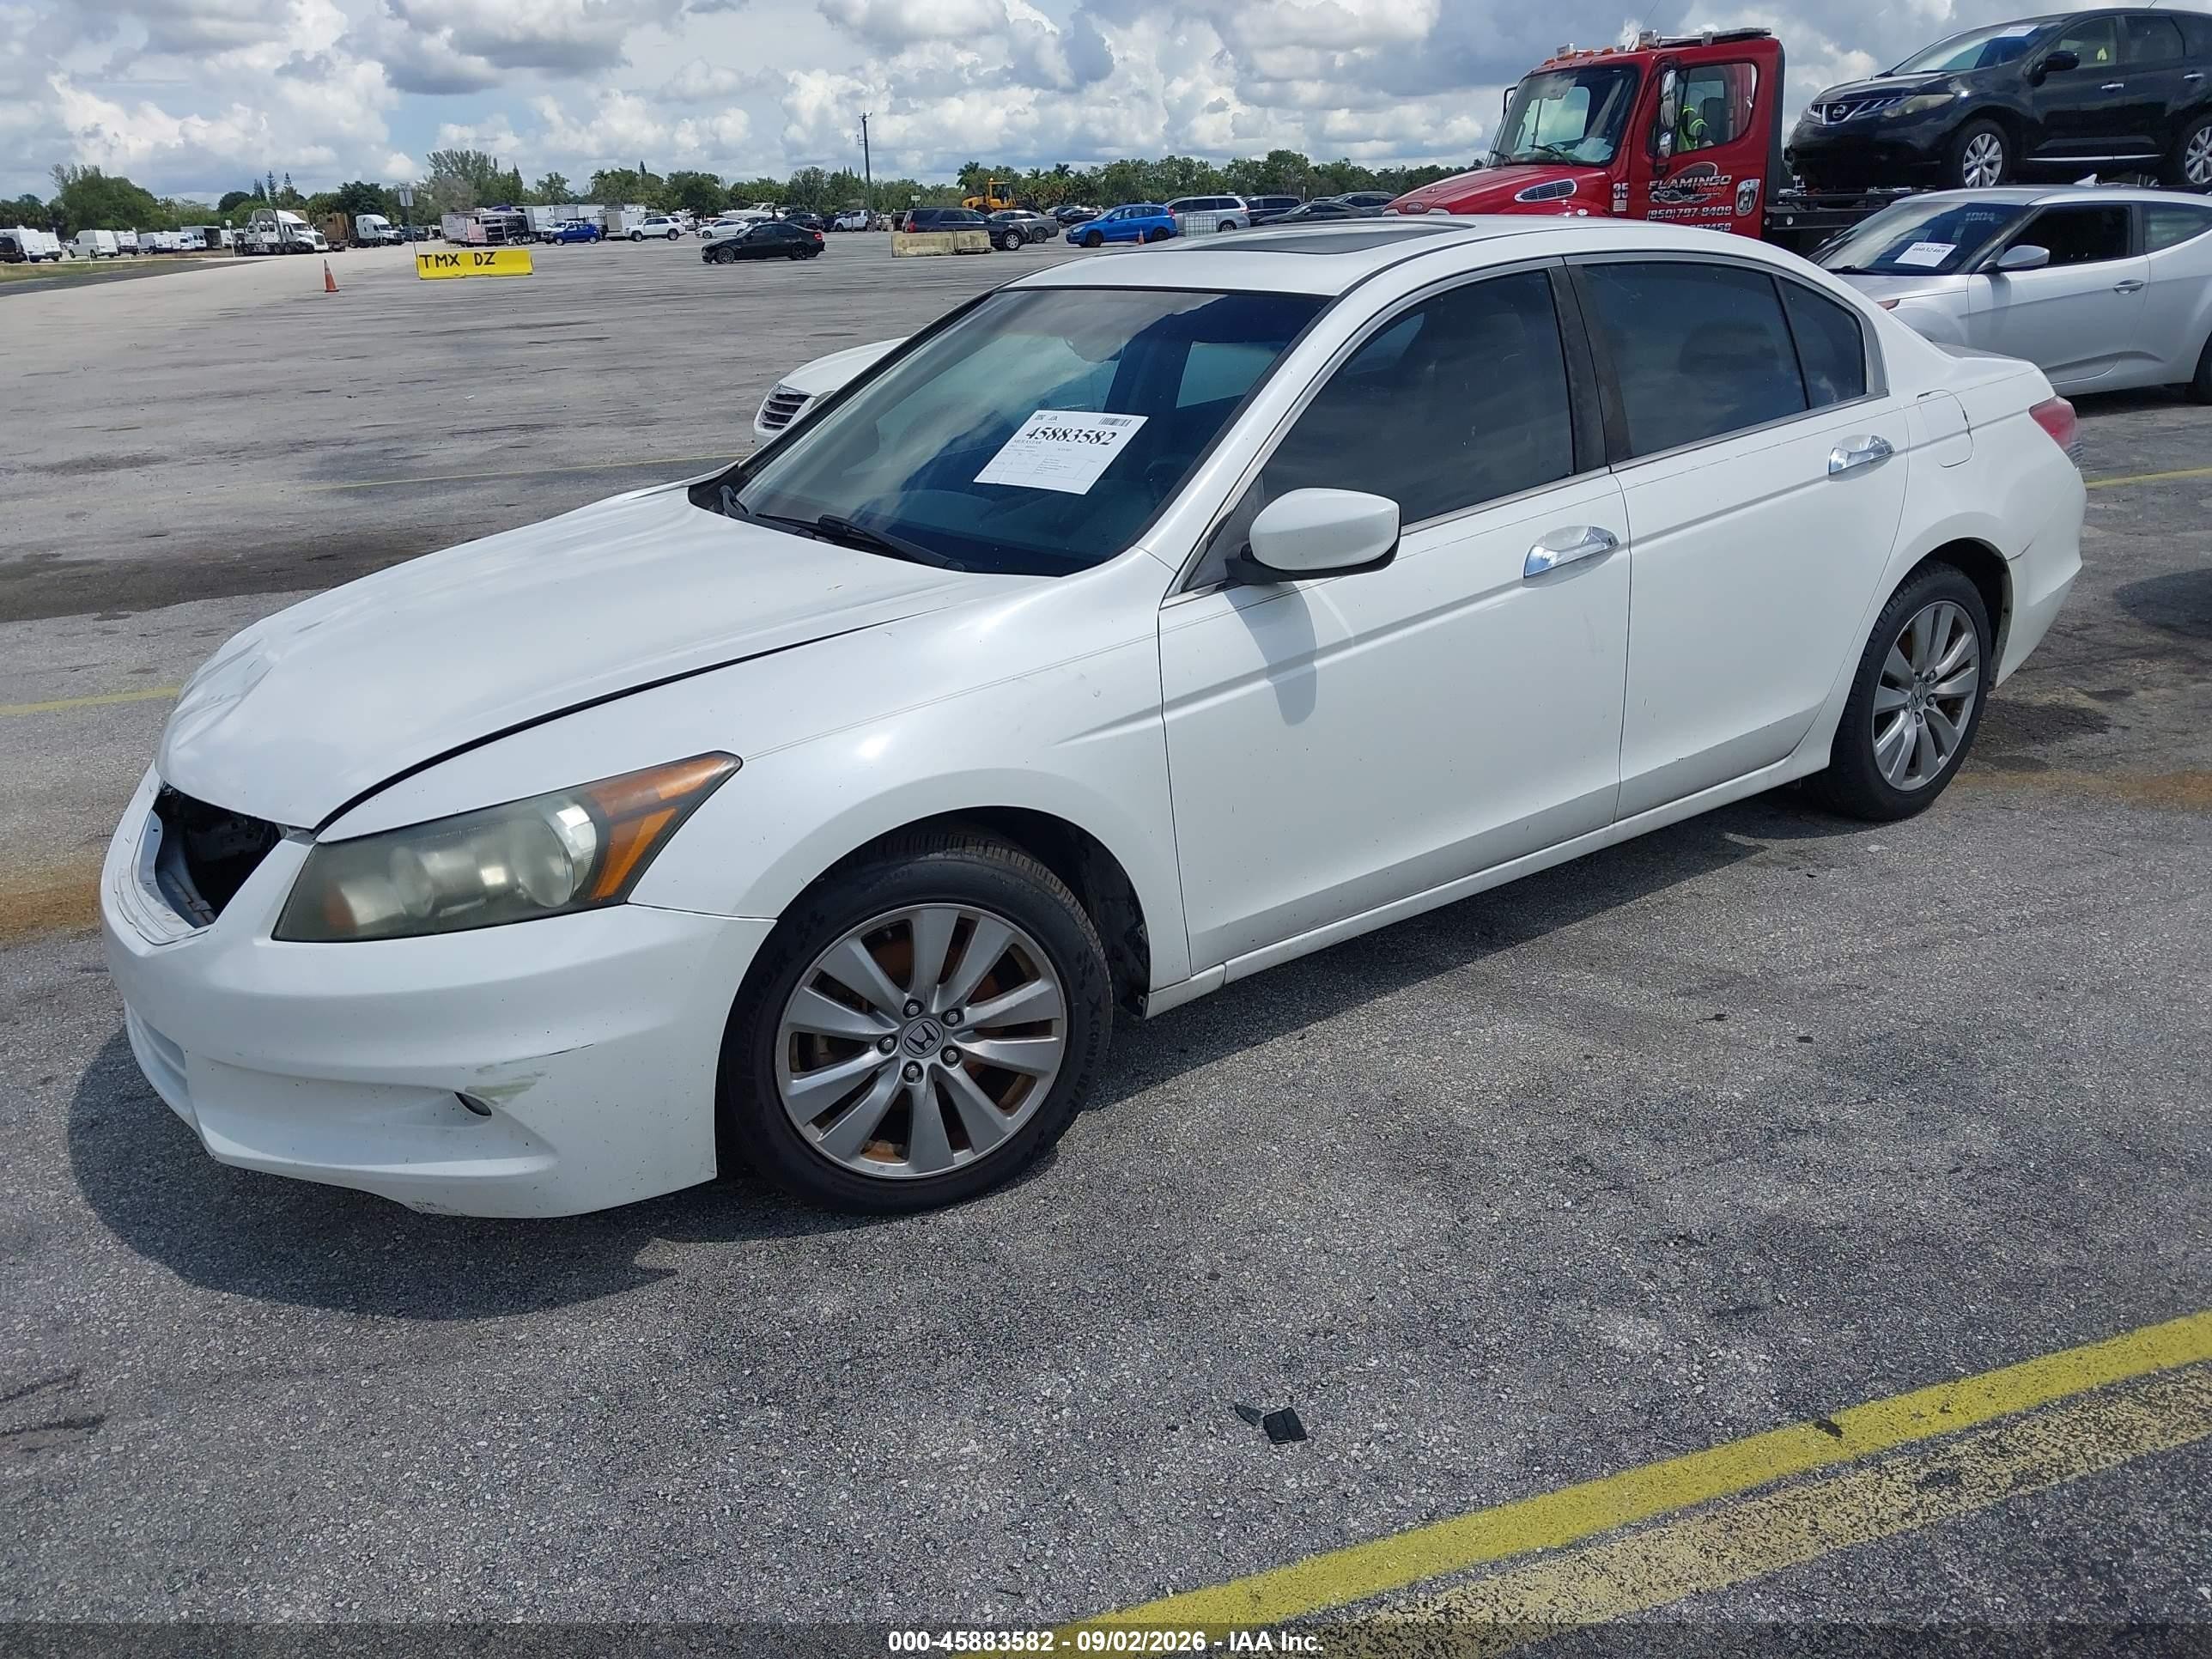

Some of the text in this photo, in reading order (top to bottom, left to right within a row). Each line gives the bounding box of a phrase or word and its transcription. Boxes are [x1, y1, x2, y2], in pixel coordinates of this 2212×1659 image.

[1613, 182, 1629, 199] 35
[1648, 175, 1732, 191] FLAMINGO
[419, 252, 496, 269] TMX DZ
[1025, 426, 1117, 446] 45883582
